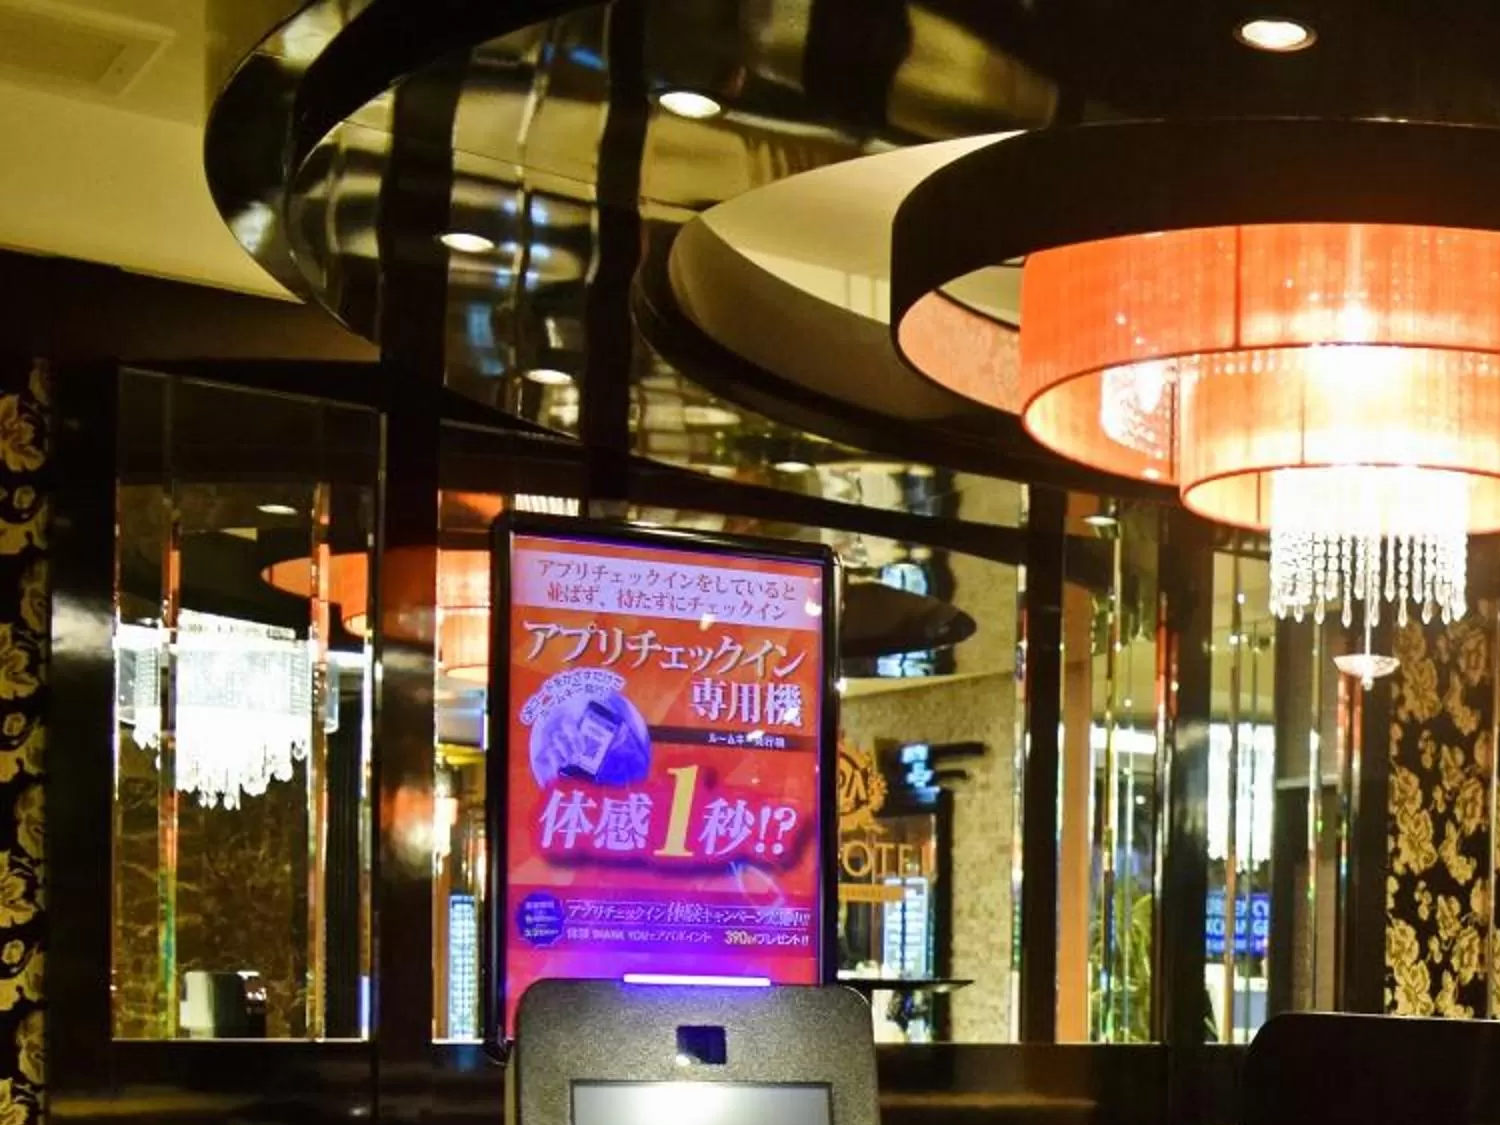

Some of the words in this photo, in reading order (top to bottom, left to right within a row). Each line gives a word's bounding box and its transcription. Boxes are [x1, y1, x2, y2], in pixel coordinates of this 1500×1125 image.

[523, 619, 806, 677] アプリチェックイン
[690, 677, 803, 727] 専用機
